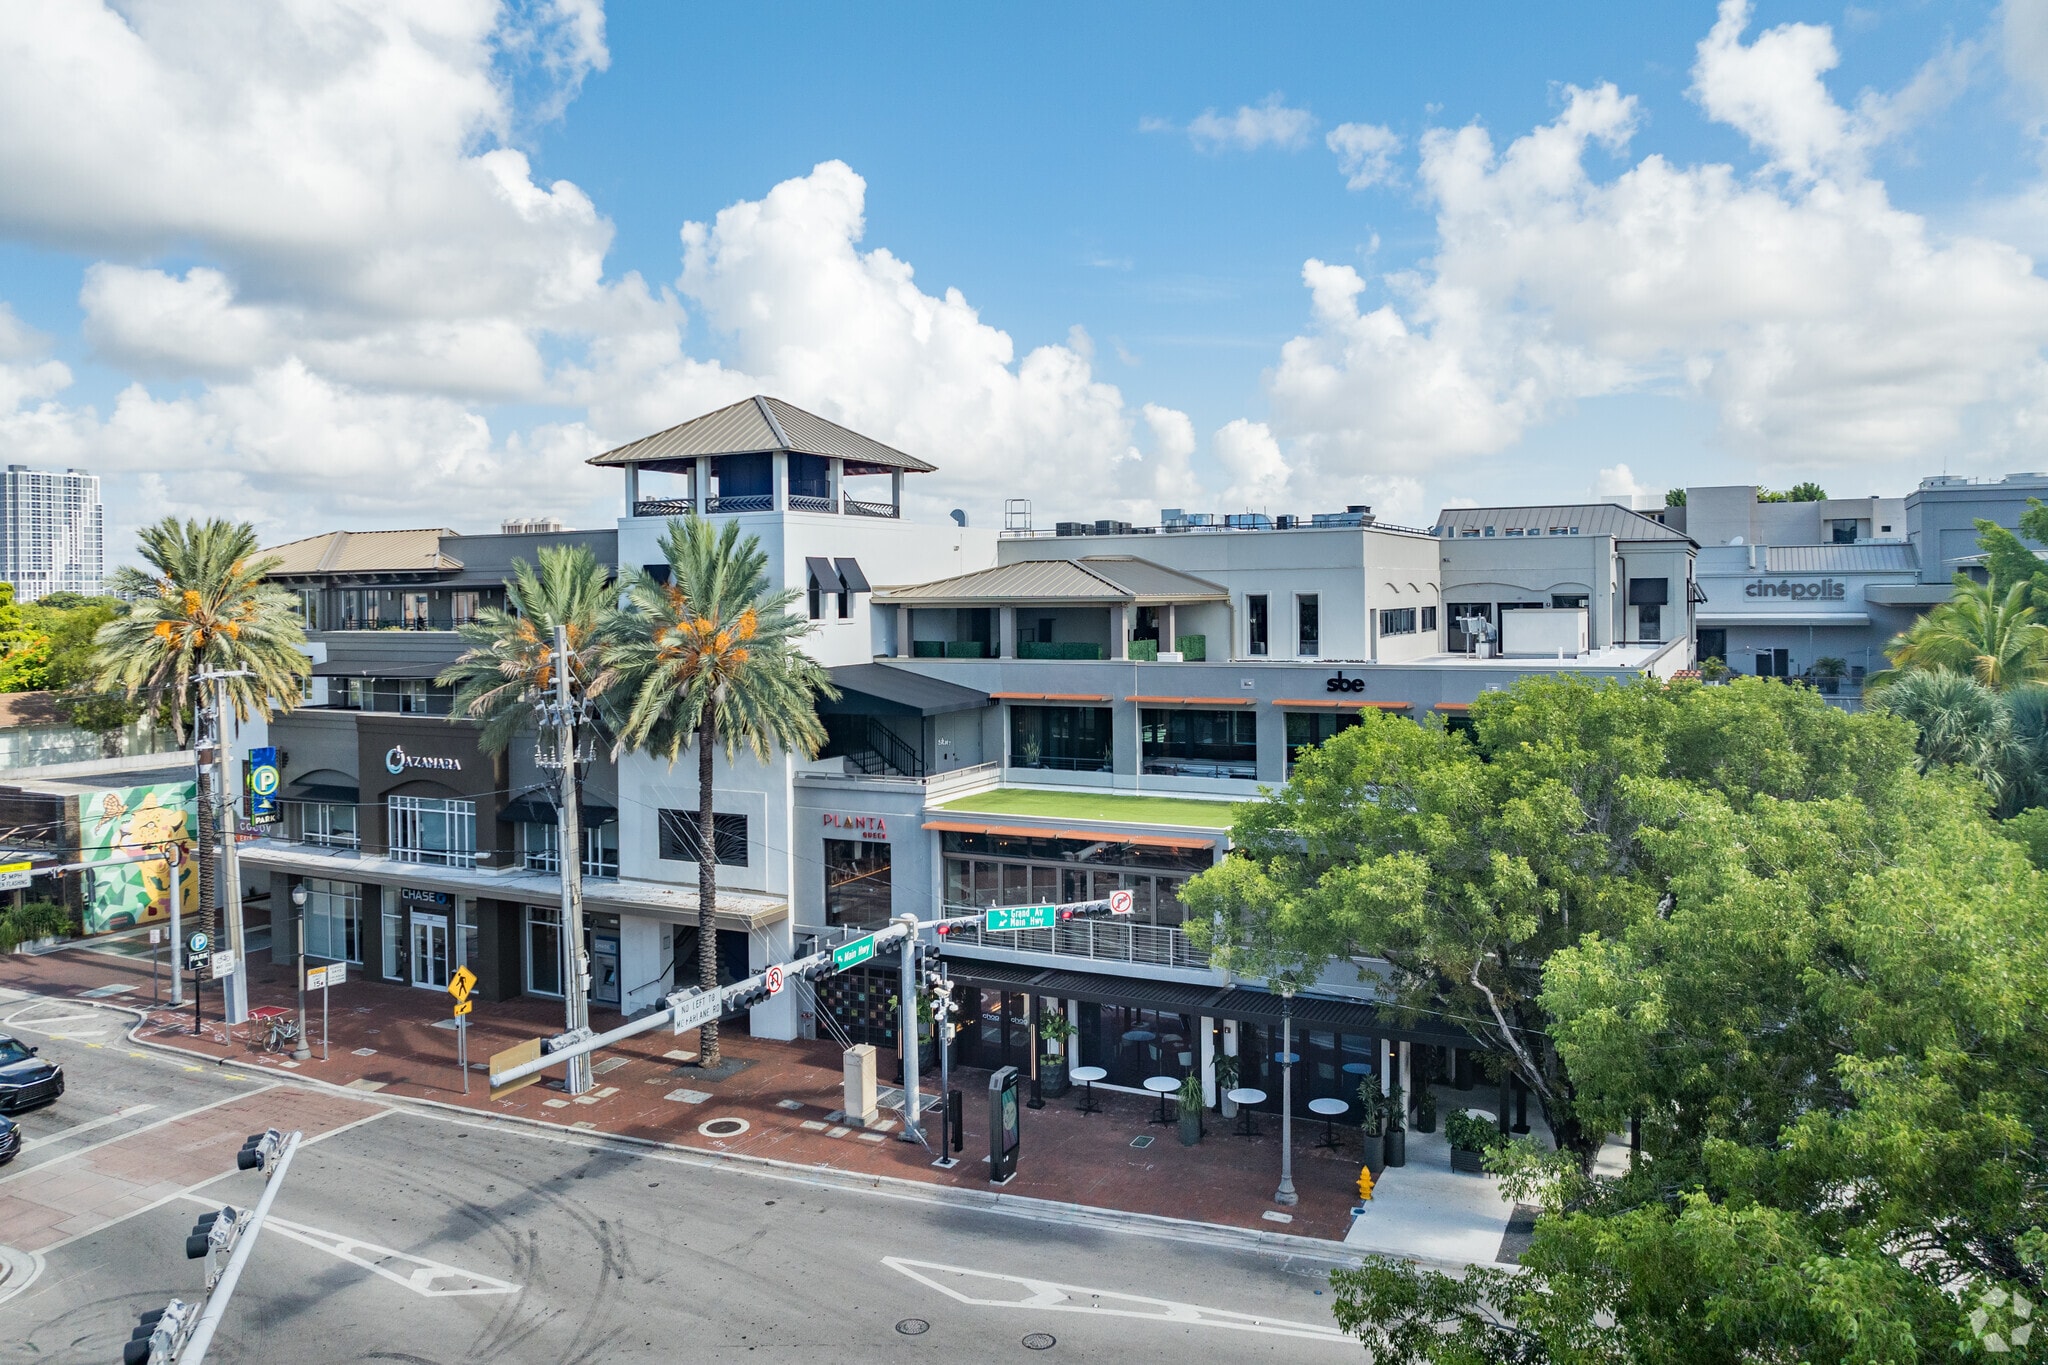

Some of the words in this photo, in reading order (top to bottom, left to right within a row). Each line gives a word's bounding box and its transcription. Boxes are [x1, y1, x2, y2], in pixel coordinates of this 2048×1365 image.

[1745, 579, 1845, 600] cinépolis
[1327, 671, 1365, 692] sbe
[260, 772, 274, 792] P
[255, 815, 276, 825] PARK
[823, 814, 886, 830] PLANTA
[402, 888, 435, 902] CHASE
[1011, 908, 1029, 919] Grand
[1035, 907, 1044, 917] Av
[1010, 917, 1026, 927] Main
[1030, 916, 1044, 926] Hwy
[195, 936, 204, 949] P
[190, 952, 208, 961] PARK
[681, 1004, 690, 1014] NO
[692, 996, 706, 1010] LEFT
